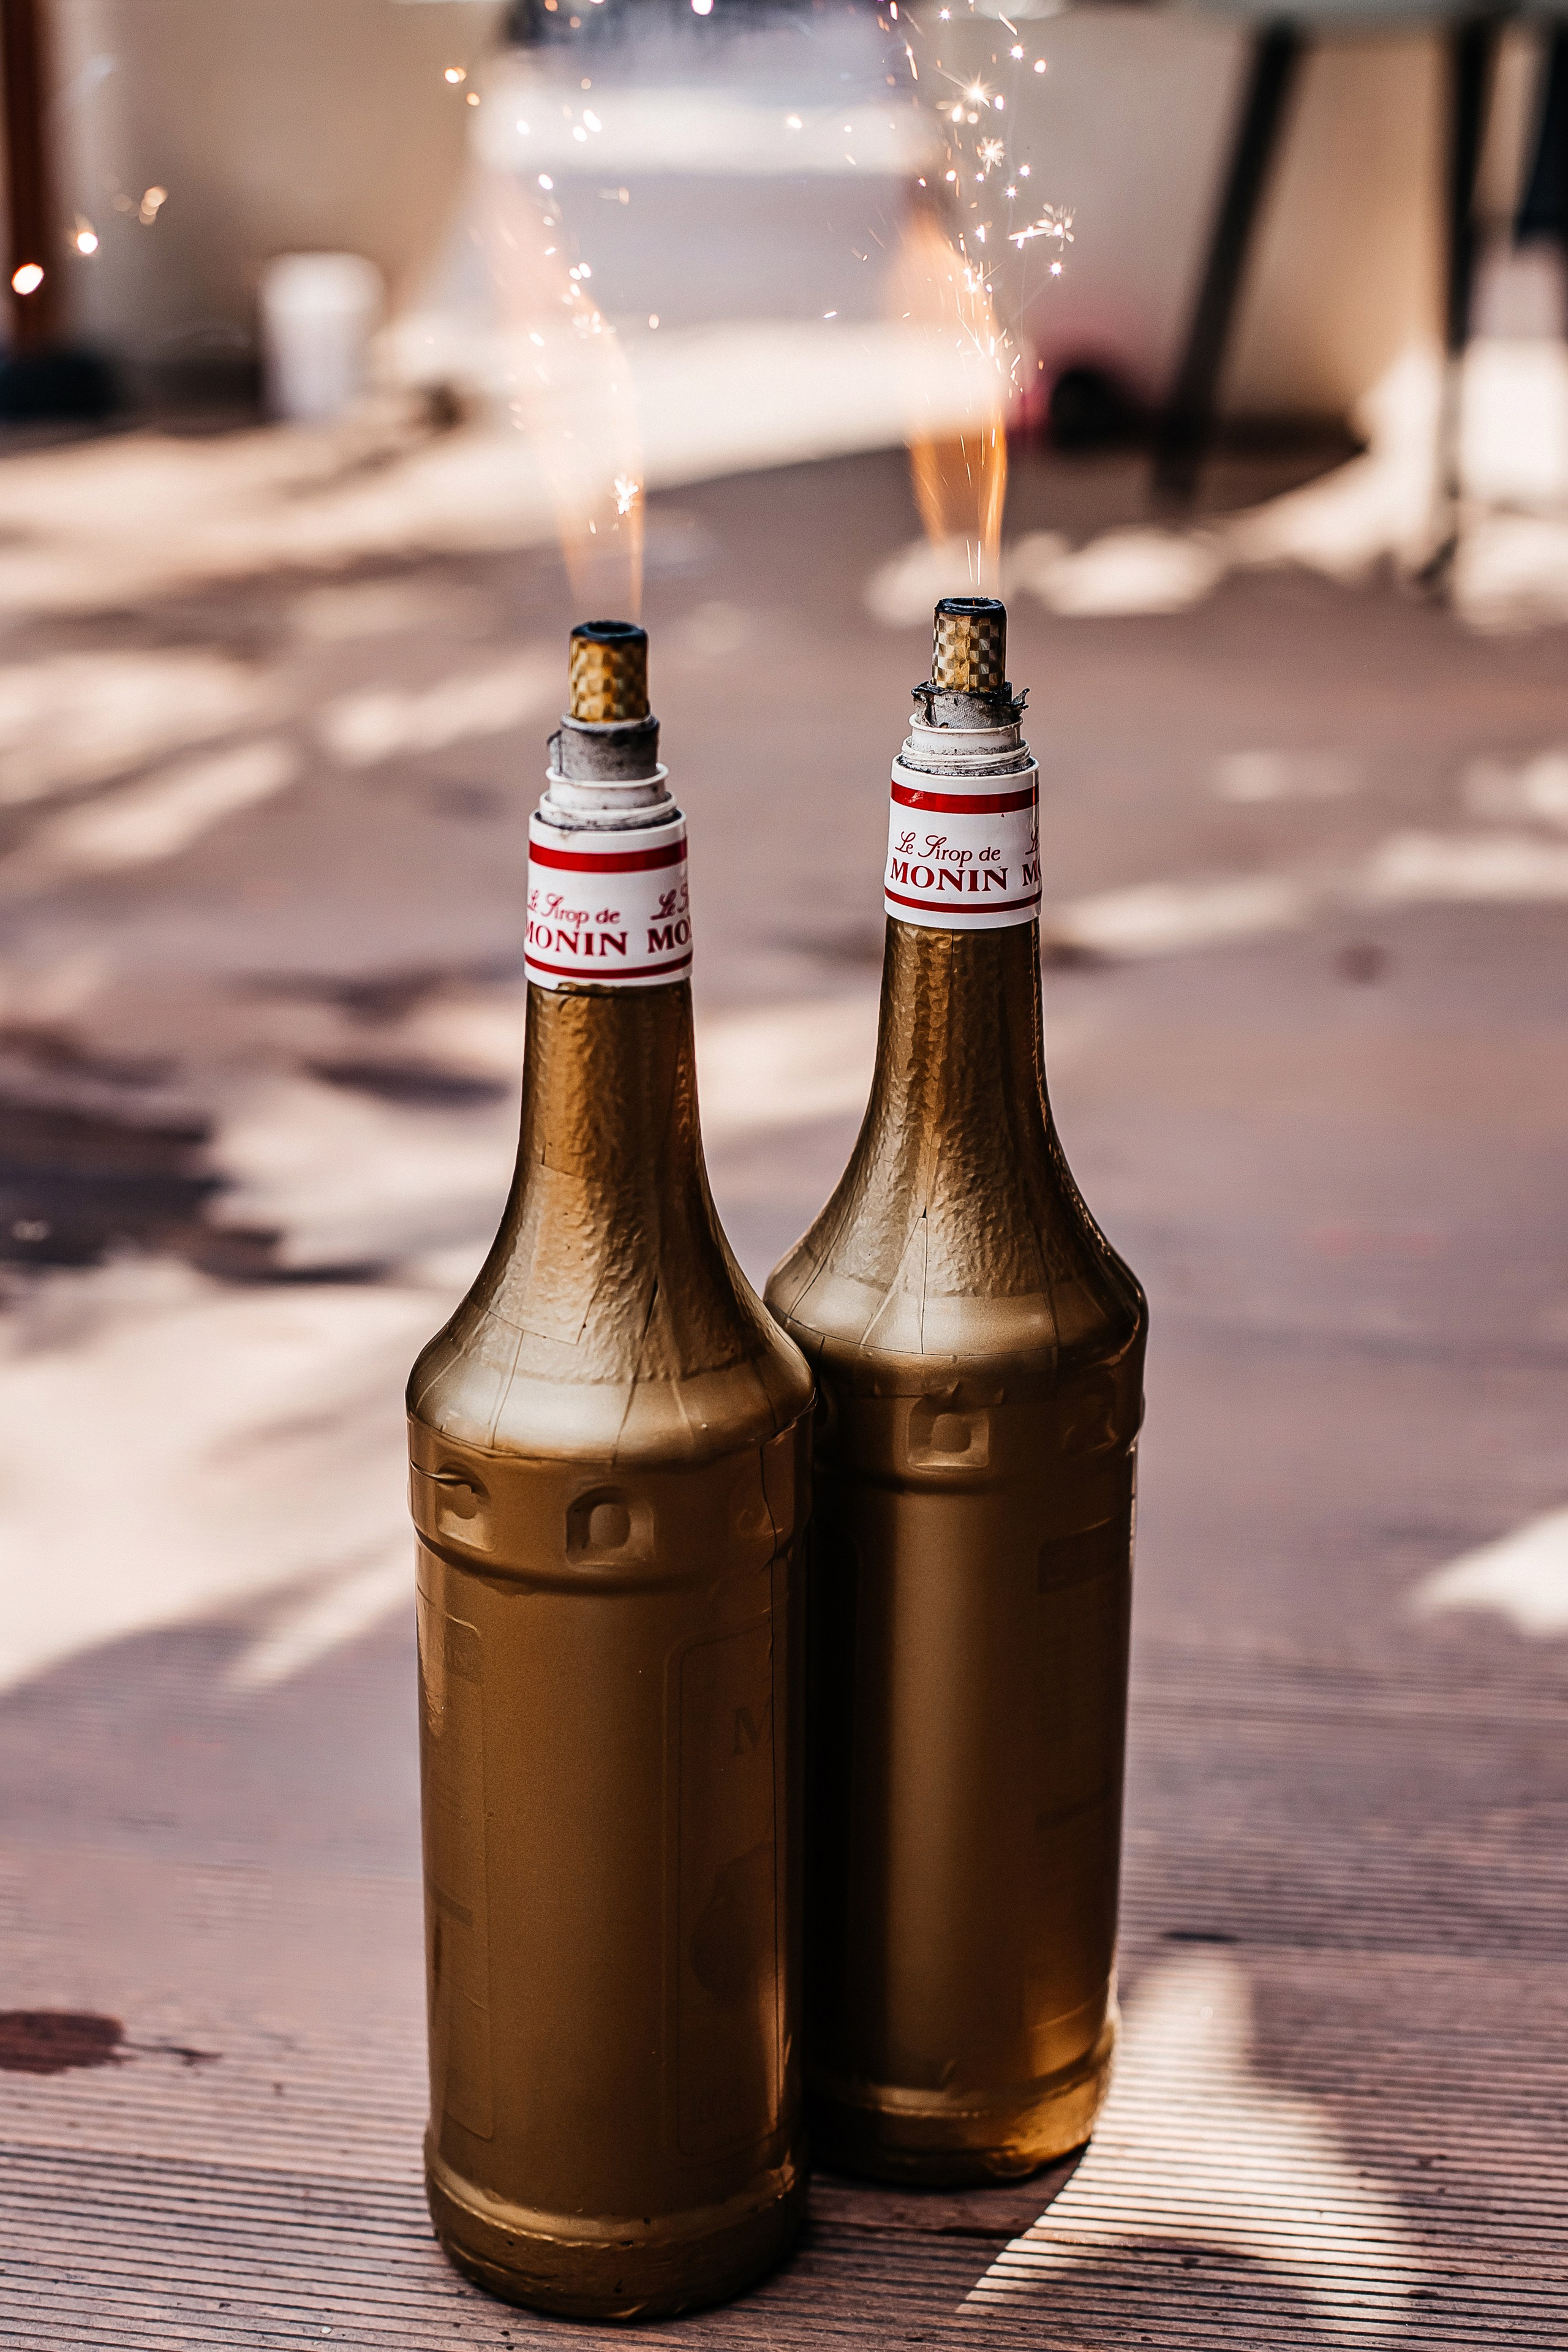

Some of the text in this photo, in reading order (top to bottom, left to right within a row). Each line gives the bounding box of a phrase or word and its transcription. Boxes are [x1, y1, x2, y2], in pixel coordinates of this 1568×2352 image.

[895, 831, 1001, 868] Le Sirop de
[890, 857, 1009, 892] MONIN
[541, 892, 590, 930] Sirop
[595, 907, 622, 925] de
[526, 921, 628, 957] MONIN
